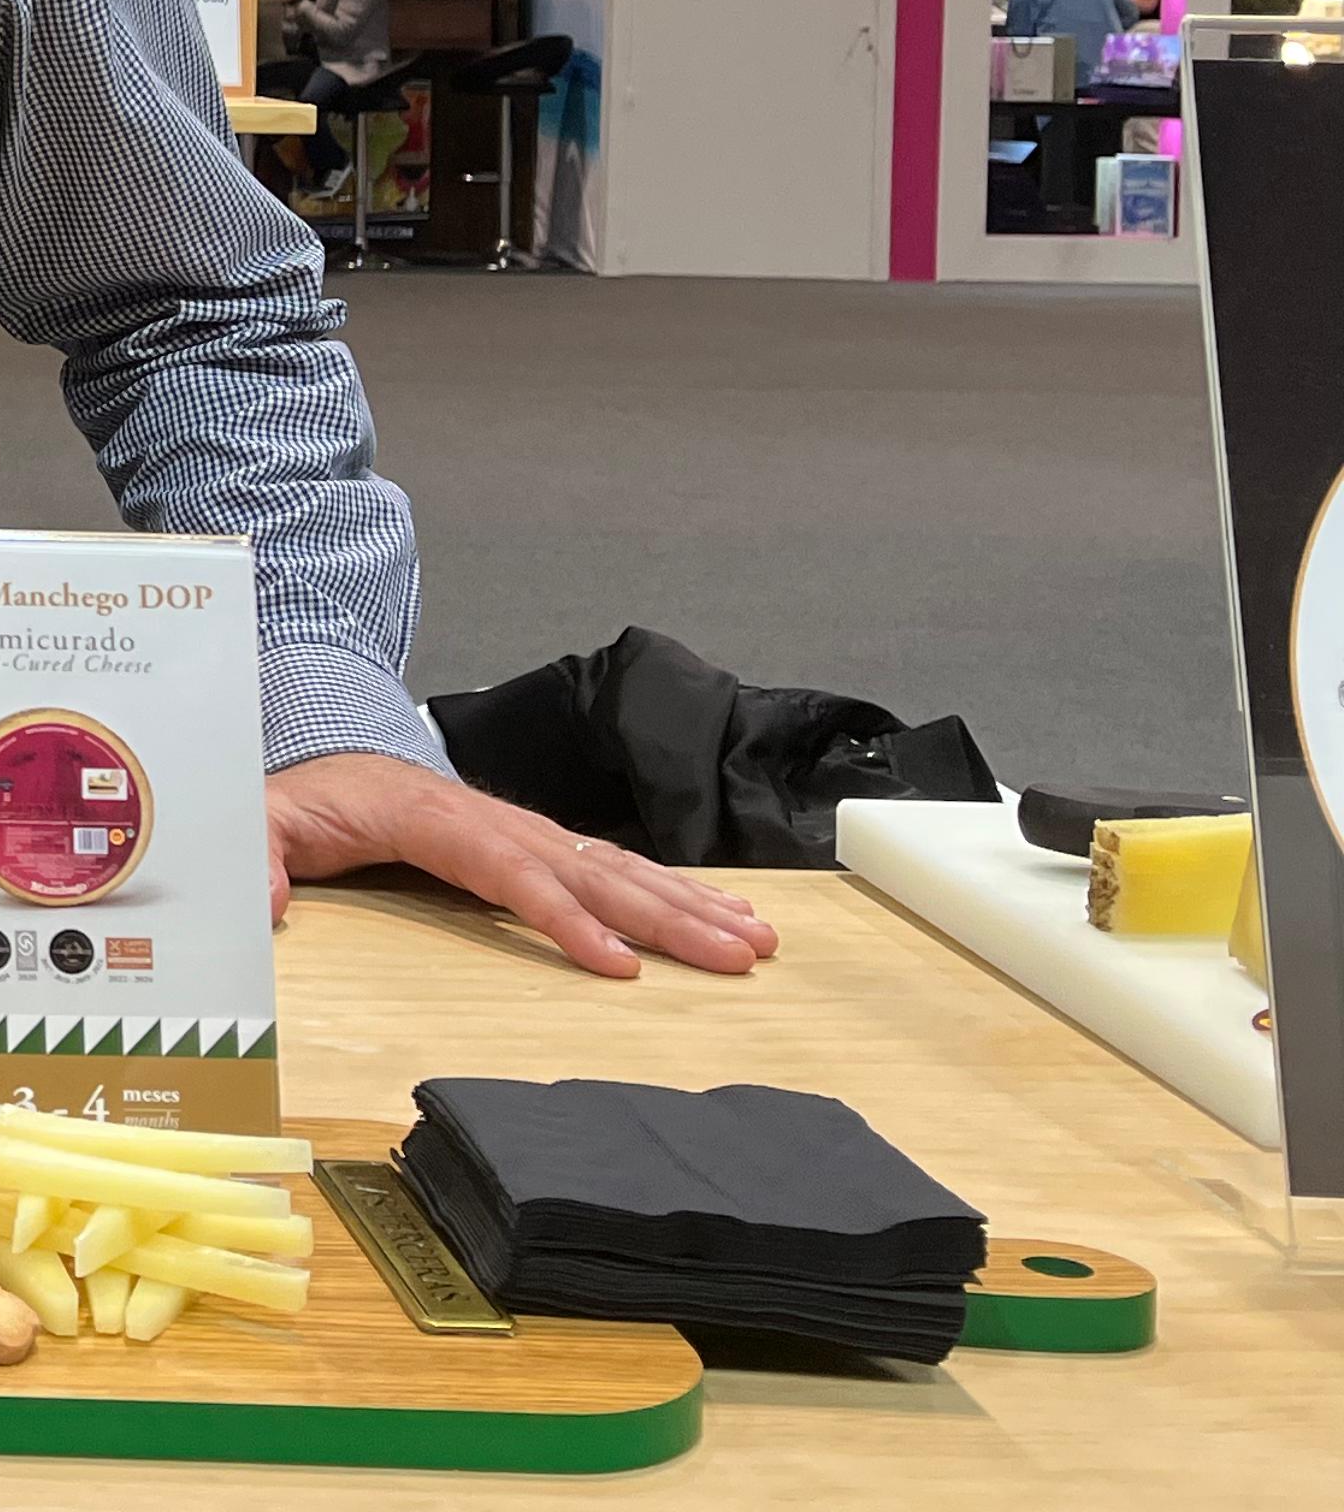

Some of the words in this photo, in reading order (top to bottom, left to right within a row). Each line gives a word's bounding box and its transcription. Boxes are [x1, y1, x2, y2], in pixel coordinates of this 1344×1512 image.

[138, 584, 213, 610] DOP
[84, 655, 153, 674] Cheese
[81, 1084, 110, 1123] 4
[122, 1089, 181, 1103] meses
[124, 1112, 180, 1129] months
